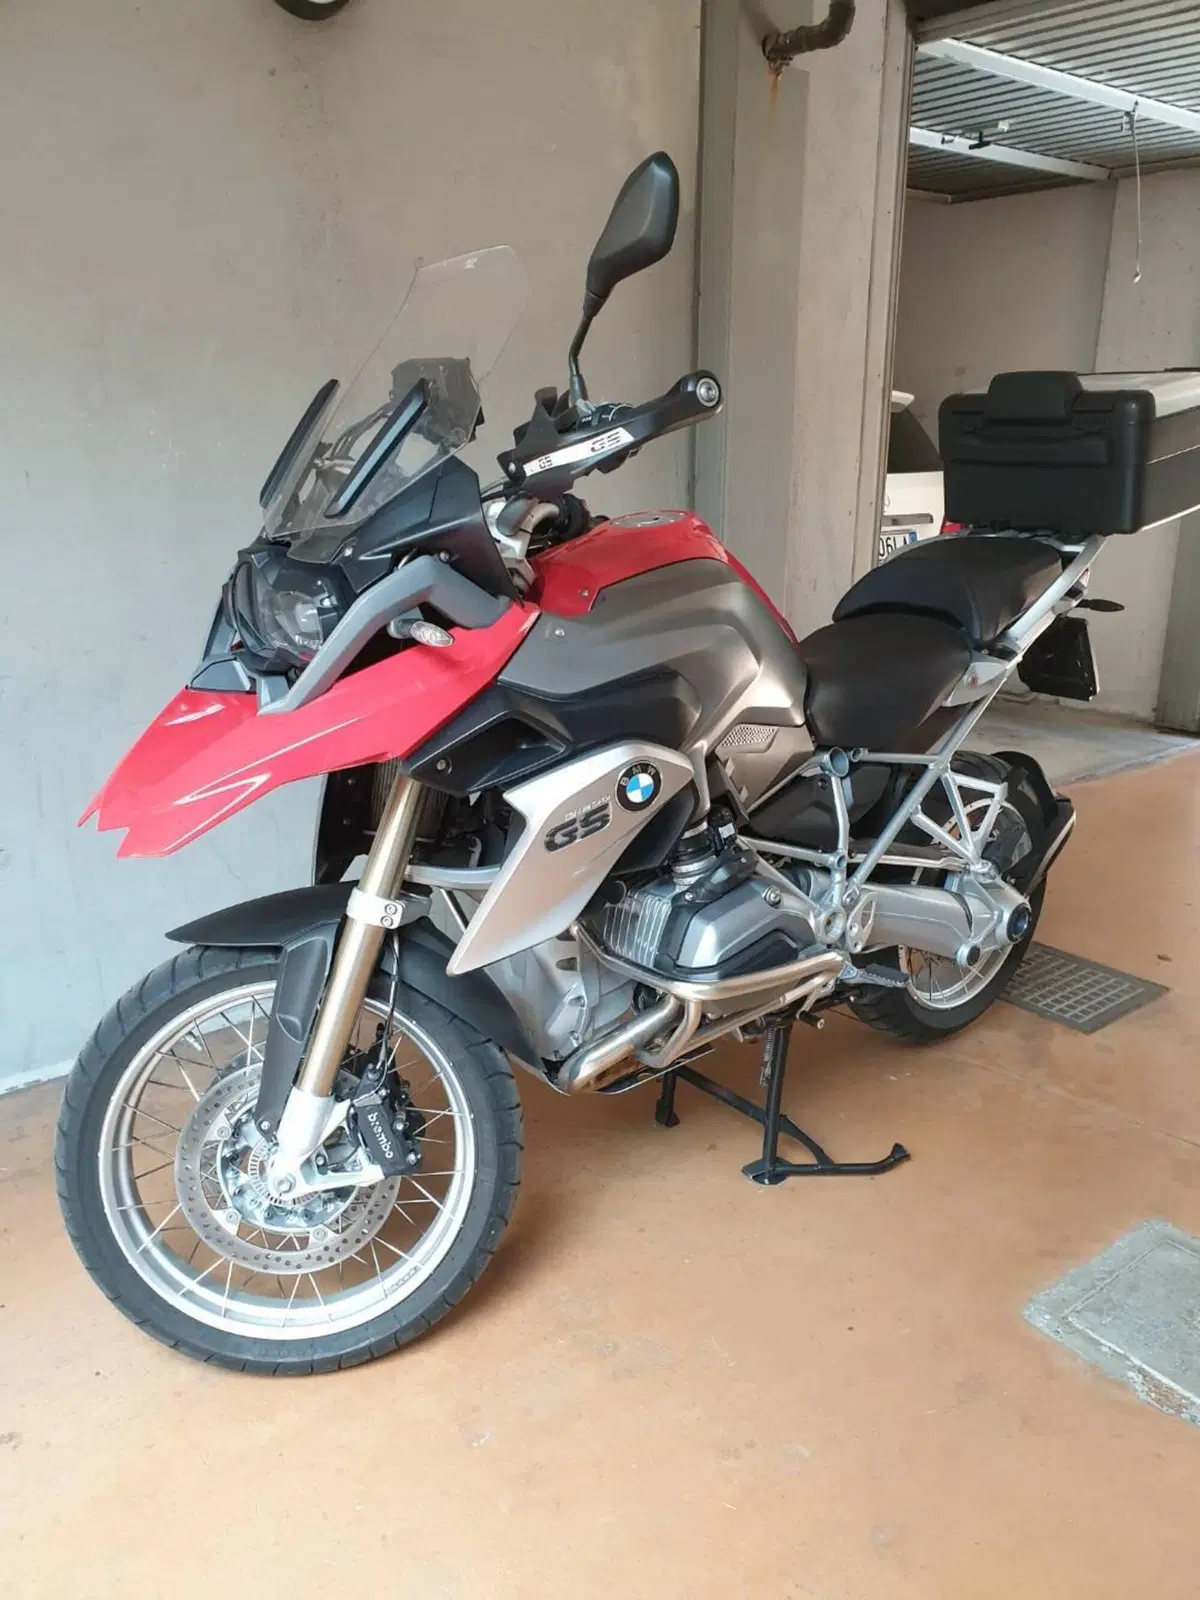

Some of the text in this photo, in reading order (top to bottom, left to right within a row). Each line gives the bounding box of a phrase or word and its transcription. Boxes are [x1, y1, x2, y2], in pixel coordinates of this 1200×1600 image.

[619, 764, 657, 787] BMW
[543, 802, 612, 853] GS
[367, 1111, 394, 1159] brembo
